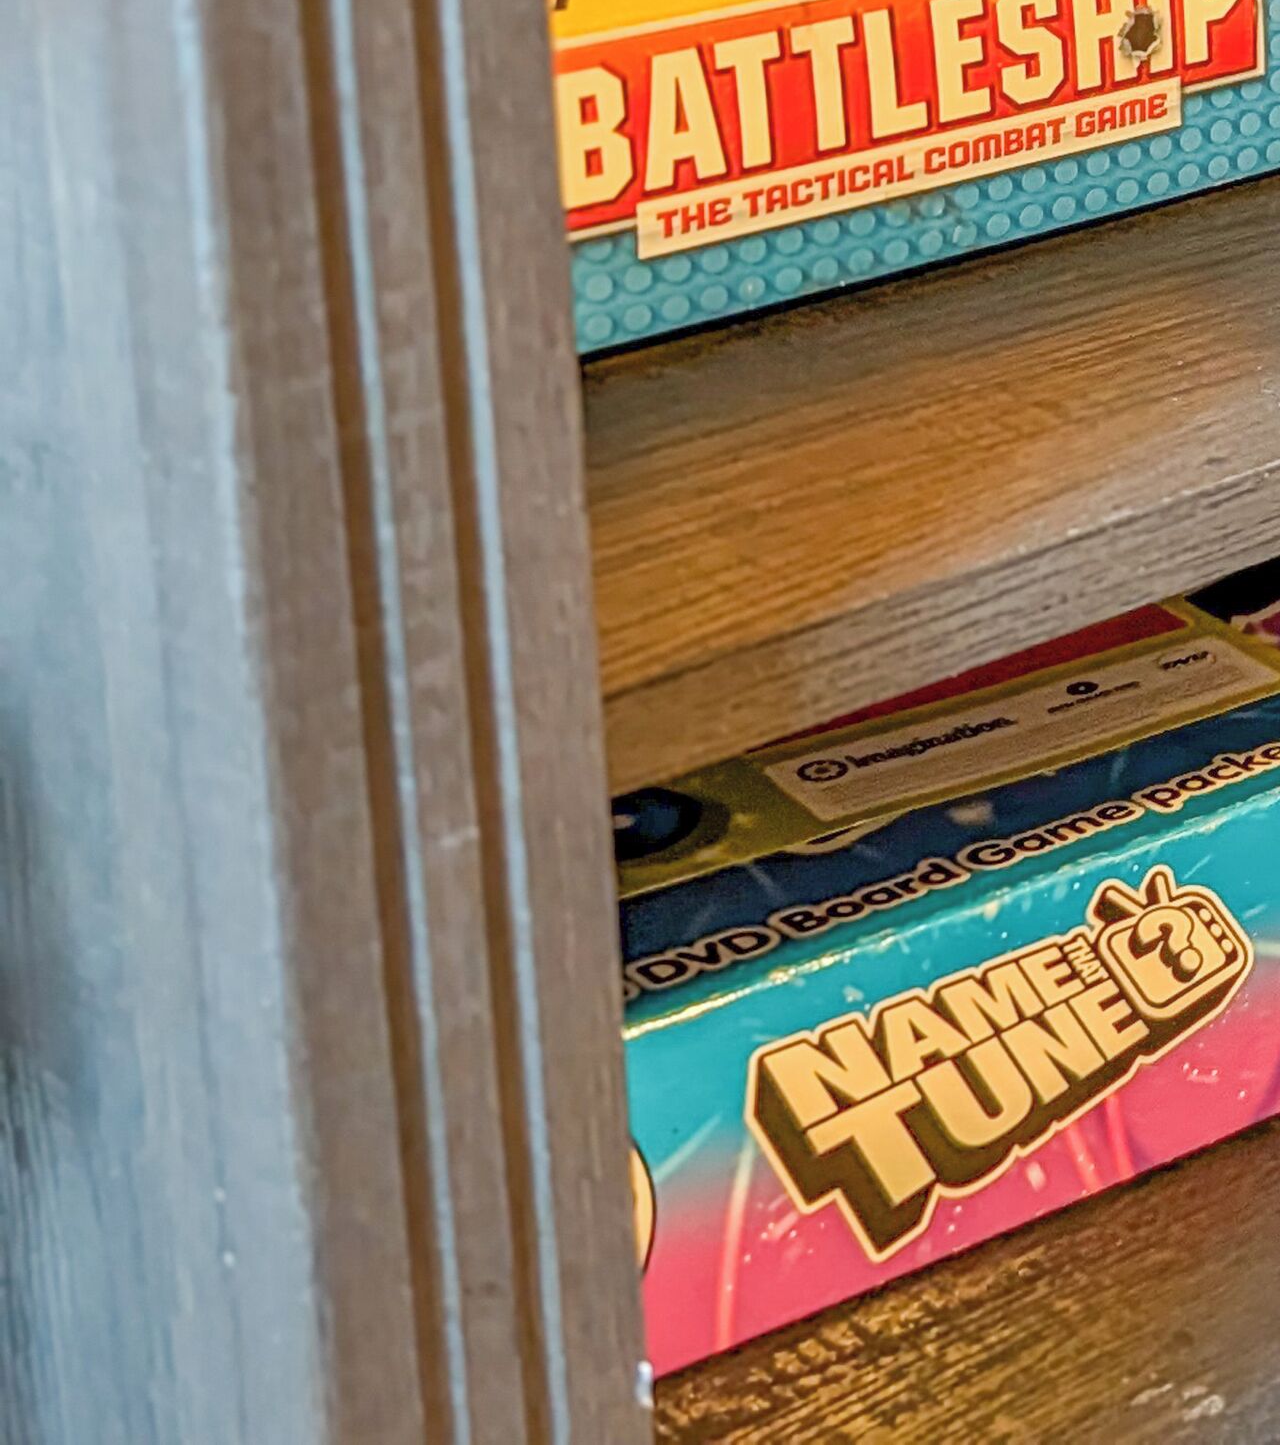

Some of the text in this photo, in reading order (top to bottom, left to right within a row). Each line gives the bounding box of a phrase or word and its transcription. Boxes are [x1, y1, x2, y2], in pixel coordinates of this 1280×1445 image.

[656, 92, 1169, 240] THE TACTICAL COMBAT GAME
[635, 929, 772, 987] DVD
[780, 856, 962, 935] Board
[964, 798, 1136, 870] Game
[1062, 933, 1110, 982] THAT
[763, 946, 1086, 1125] NAME
[803, 984, 1150, 1208] TUNE
